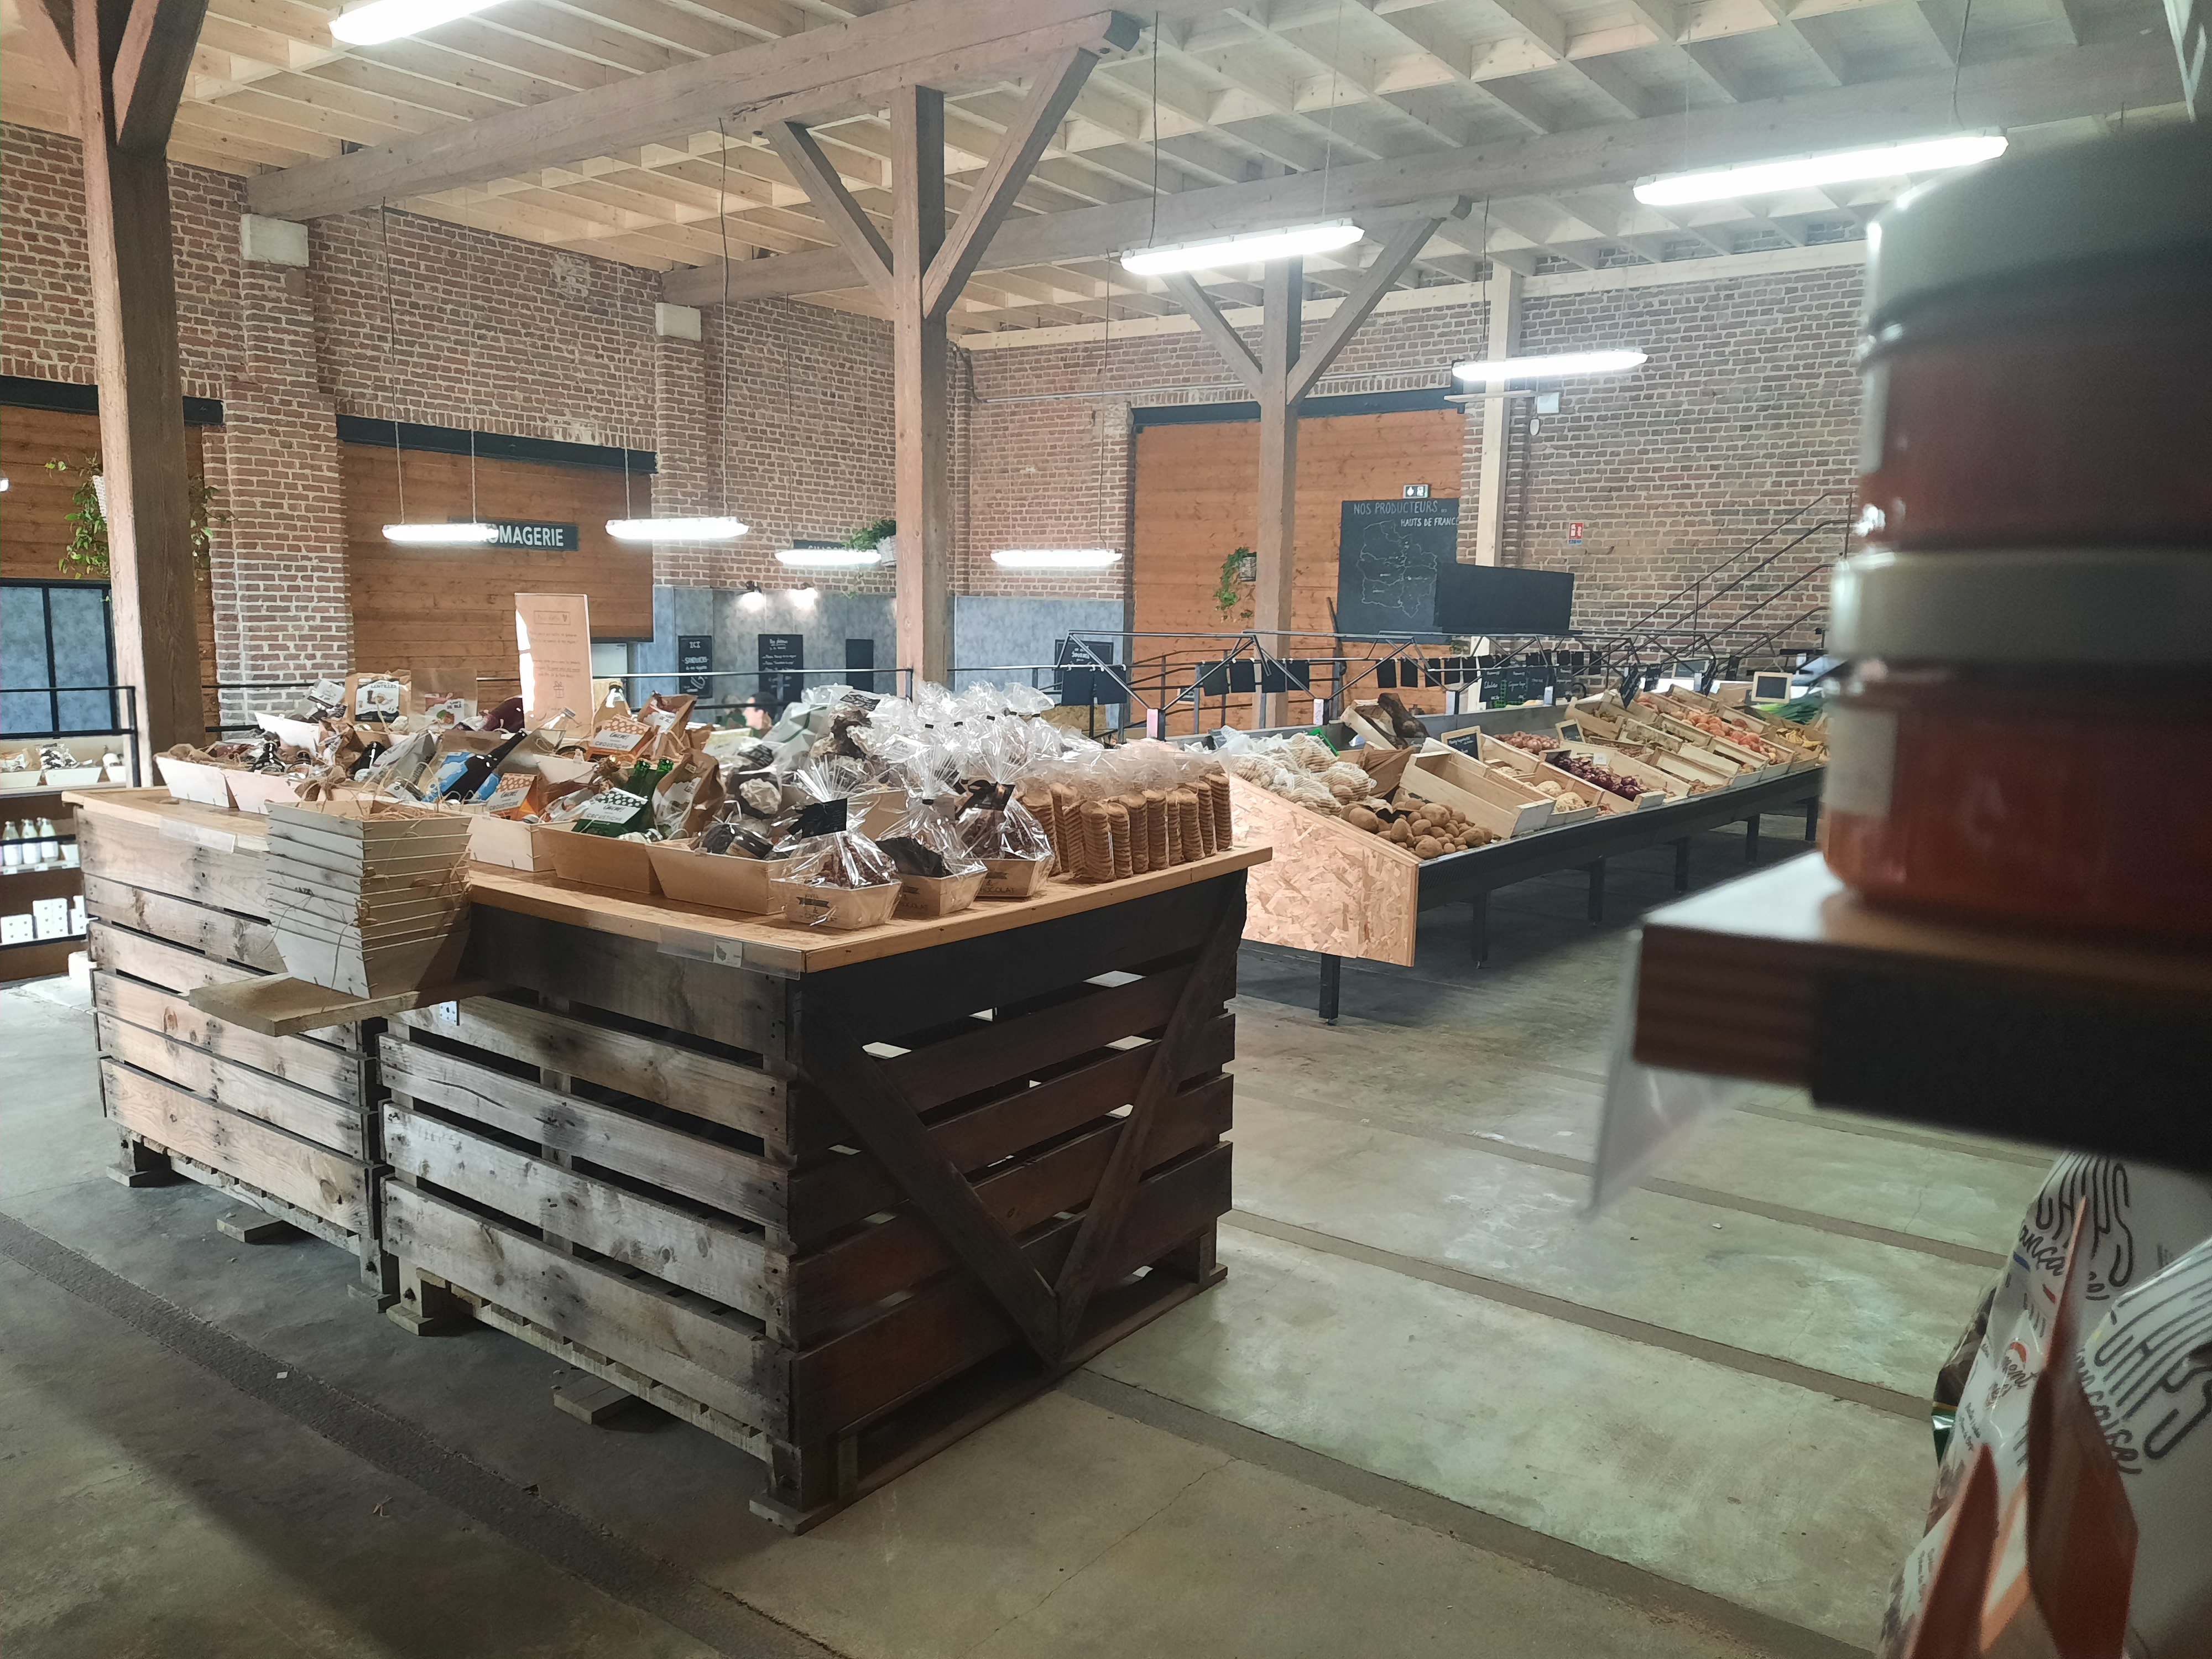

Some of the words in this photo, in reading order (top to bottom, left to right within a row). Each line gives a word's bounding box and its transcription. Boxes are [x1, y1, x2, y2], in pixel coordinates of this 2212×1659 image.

[1353, 502, 1371, 515] NOS
[1374, 500, 1438, 515] PRODUCTEURS
[1400, 518, 1422, 528] HAUTS
[1423, 517, 1432, 527] DE
